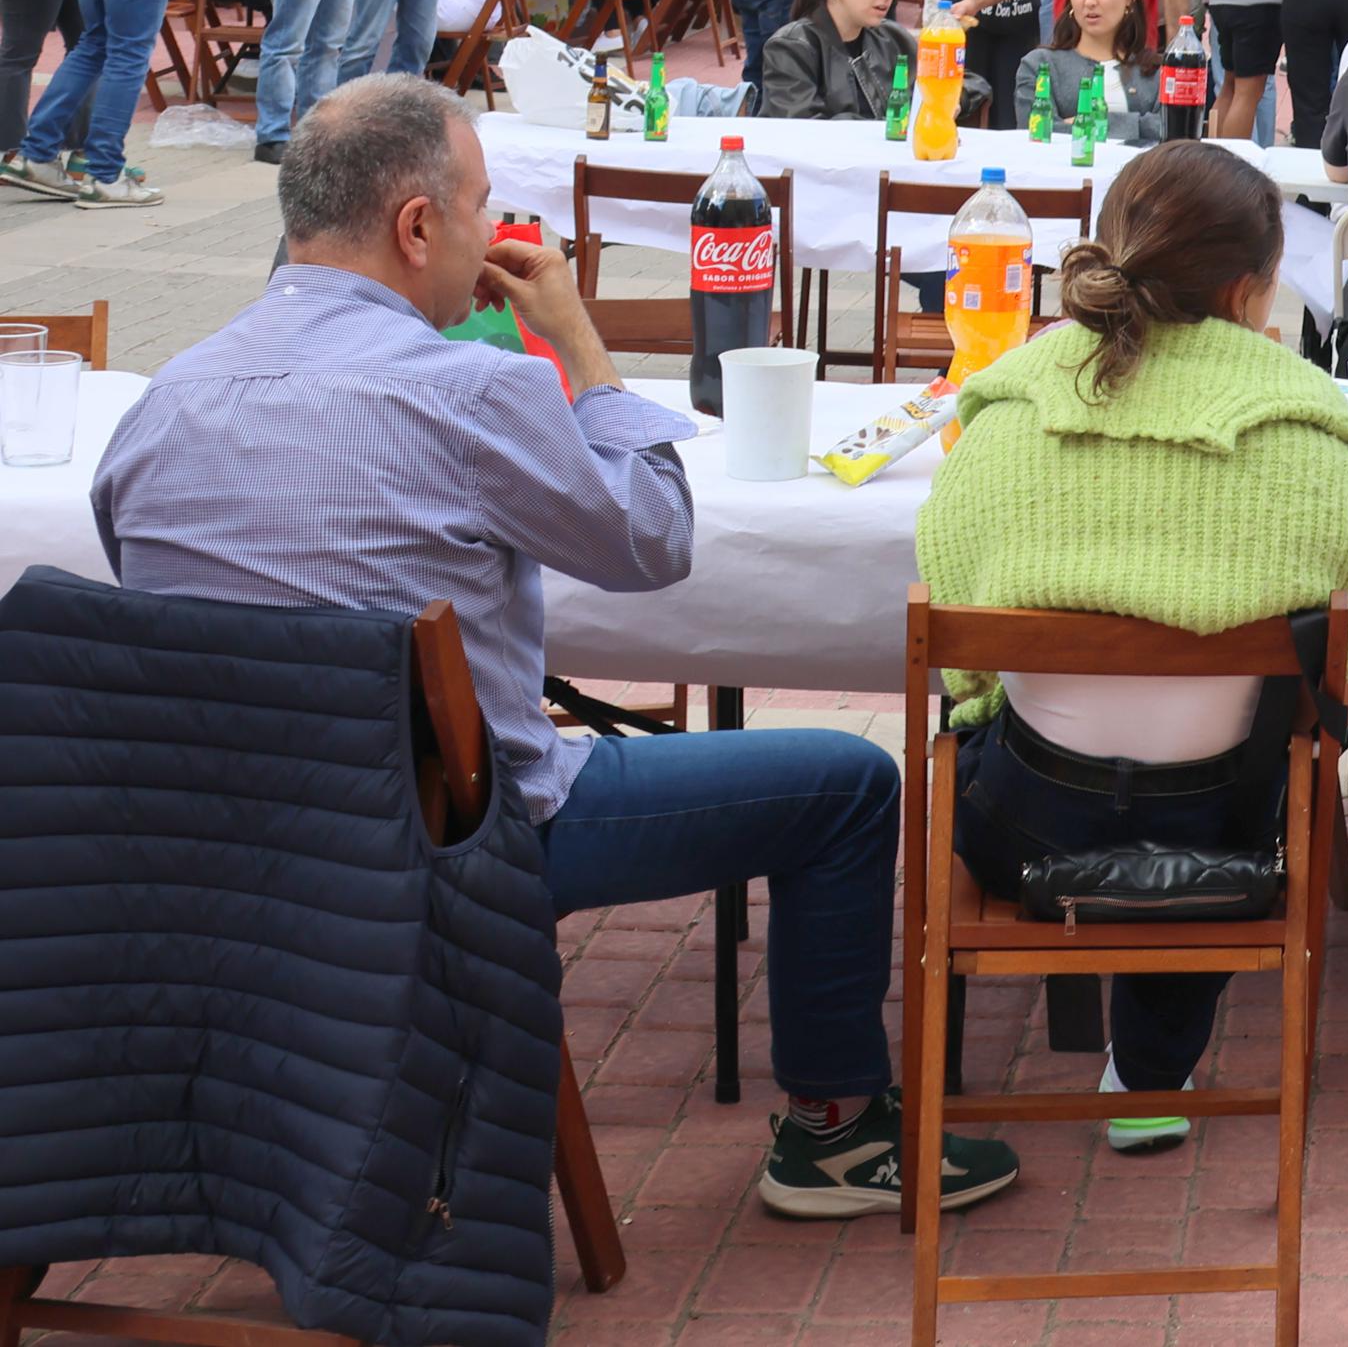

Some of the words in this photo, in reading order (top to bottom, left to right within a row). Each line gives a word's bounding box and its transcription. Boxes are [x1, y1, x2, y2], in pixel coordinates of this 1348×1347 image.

[995, 2, 1010, 18] Don
[1011, 1, 1033, 16] Juan
[702, 273, 735, 283] SABOR
